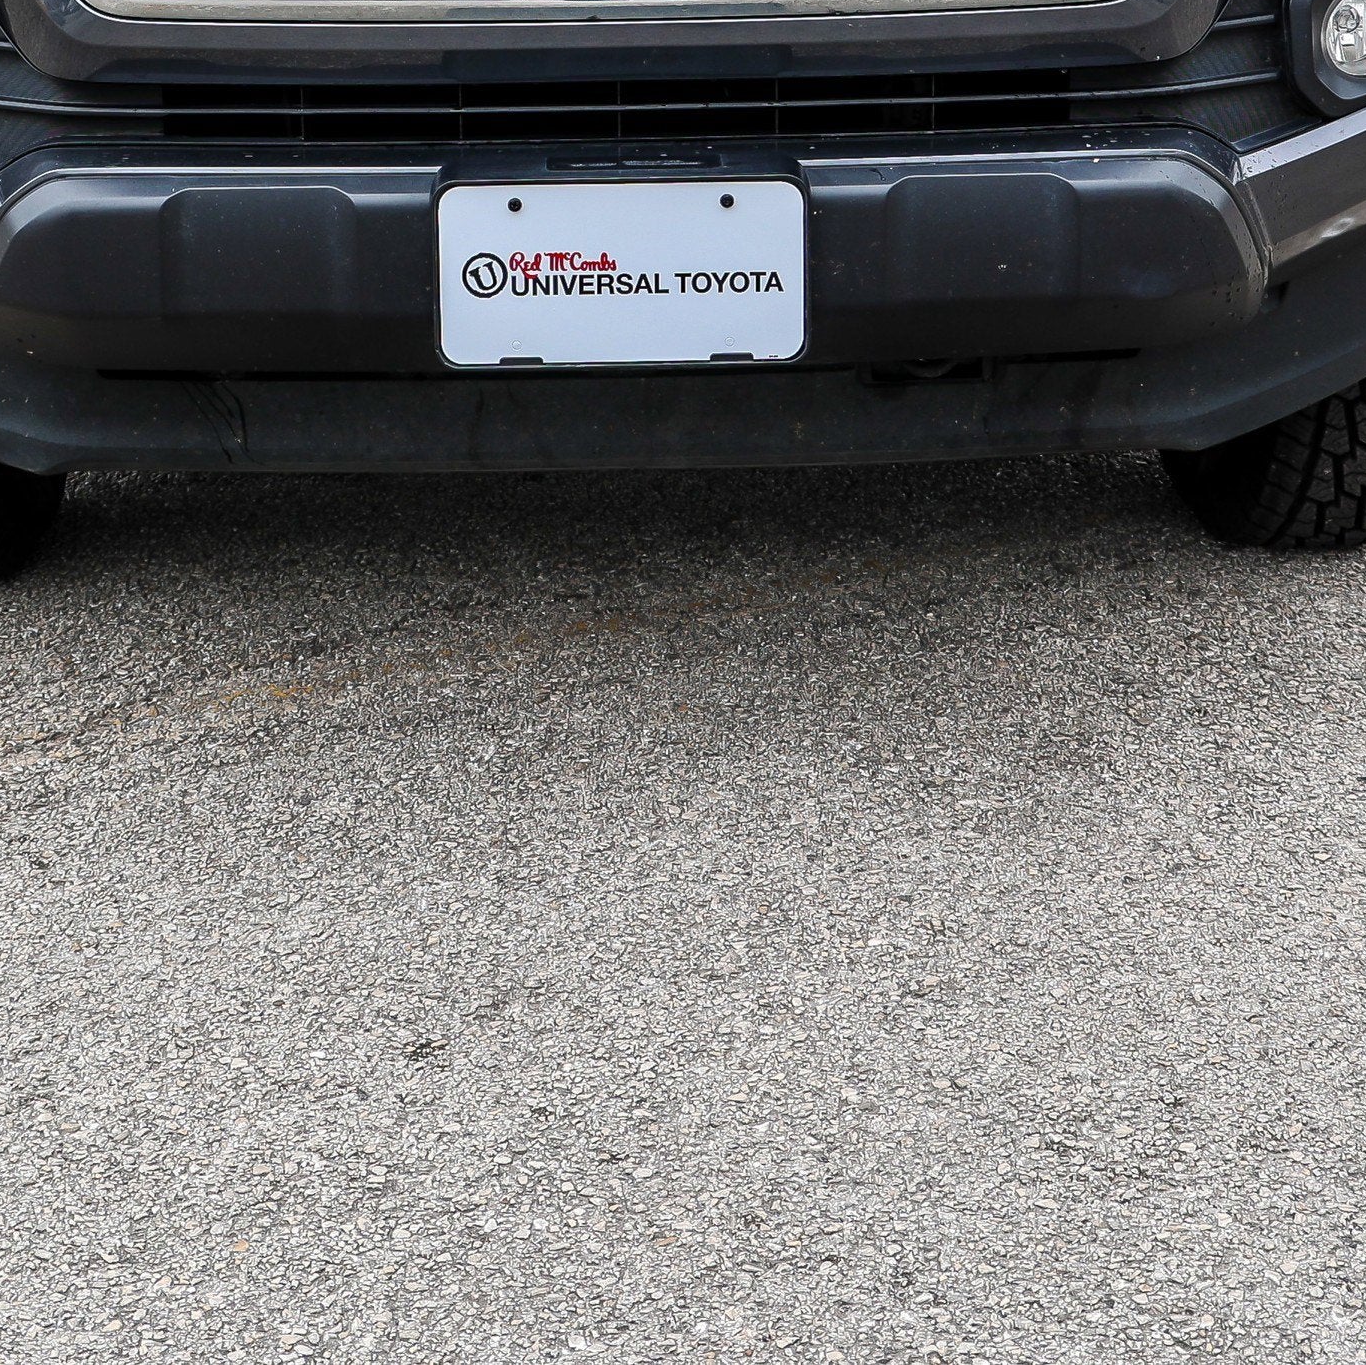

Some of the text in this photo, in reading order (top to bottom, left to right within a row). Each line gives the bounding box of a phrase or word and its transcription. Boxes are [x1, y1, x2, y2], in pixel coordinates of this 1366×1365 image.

[509, 251, 617, 279] Red McCombs
[511, 271, 784, 296] UNIVERSAL TOYOTA
